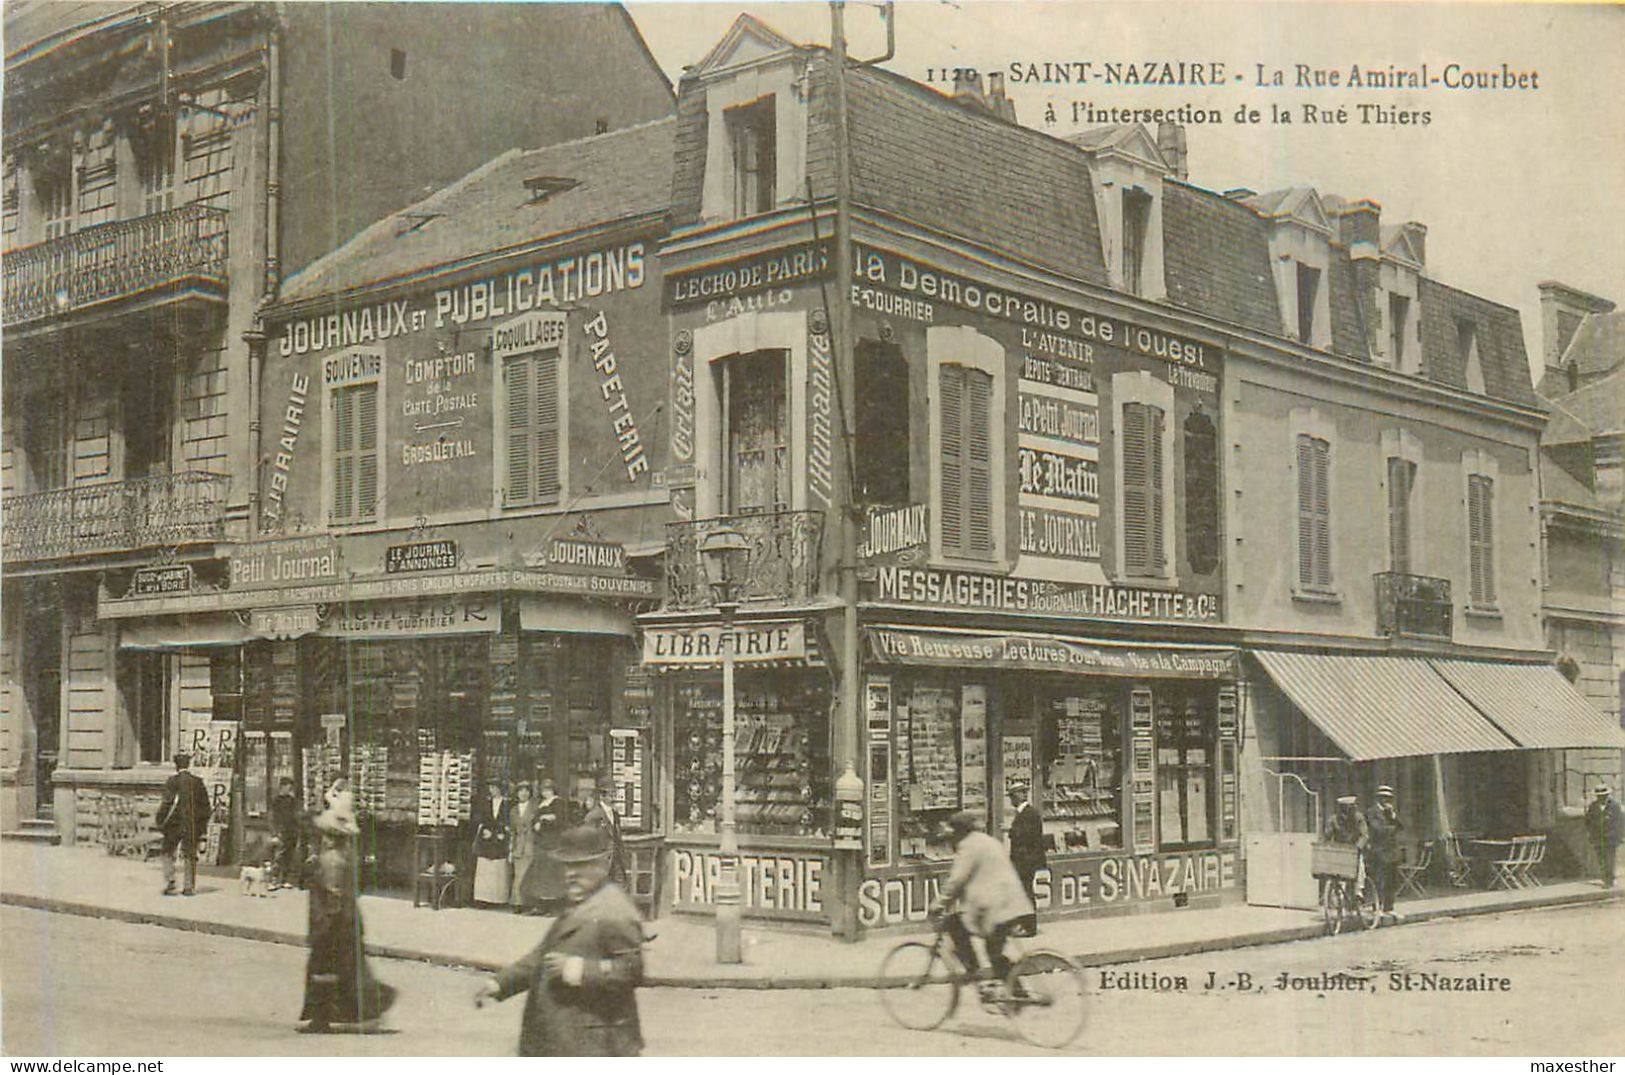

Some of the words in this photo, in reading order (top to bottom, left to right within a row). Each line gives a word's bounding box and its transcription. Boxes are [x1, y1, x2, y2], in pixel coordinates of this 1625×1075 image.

[740, 266, 762, 288] DE
[280, 300, 409, 356] JOURNAUX
[411, 310, 427, 331] ET
[435, 243, 644, 328] PUBLICATIONS
[866, 289, 934, 323] COURRIER
[496, 320, 564, 350] COQUILLAGES
[1081, 316, 1113, 341] de
[1022, 328, 1094, 364] L'AVENIR
[325, 355, 381, 383] SOUVENIRS
[405, 352, 476, 385] COMPTOIR
[402, 400, 430, 416] CARTE
[433, 392, 478, 416] POSTALE
[583, 310, 648, 483] PAPETERIE
[1018, 396, 1031, 430] Le
[1033, 399, 1059, 437] Petit
[264, 371, 309, 522] LIBRAIRIE
[402, 444, 432, 465] GROS
[433, 440, 476, 461] DETAIL
[1019, 450, 1042, 492] Le
[1043, 454, 1099, 497] Matin
[865, 504, 927, 557] JOURNAUX
[1019, 510, 1036, 552] LE
[1039, 514, 1100, 557] JOURNAL
[232, 555, 266, 583] Petit
[271, 549, 336, 580] Journal
[405, 543, 453, 559] JOURNAL
[549, 541, 622, 568] JOURNAUX
[591, 576, 653, 593] SOUVENIRS
[879, 565, 1028, 610] MESSAGERIES
[1031, 582, 1046, 595] DE
[1031, 588, 1089, 613] JOURNAUX
[1092, 584, 1184, 618] HACHETTE
[1186, 597, 1197, 618] &
[400, 614, 455, 630] QUOTIDIEN
[879, 632, 908, 655] Vie
[910, 635, 993, 659] Heureuse
[1001, 638, 1066, 663] Lectures
[1062, 874, 1091, 905] DE
[1124, 853, 1236, 900] NAZAIRE
